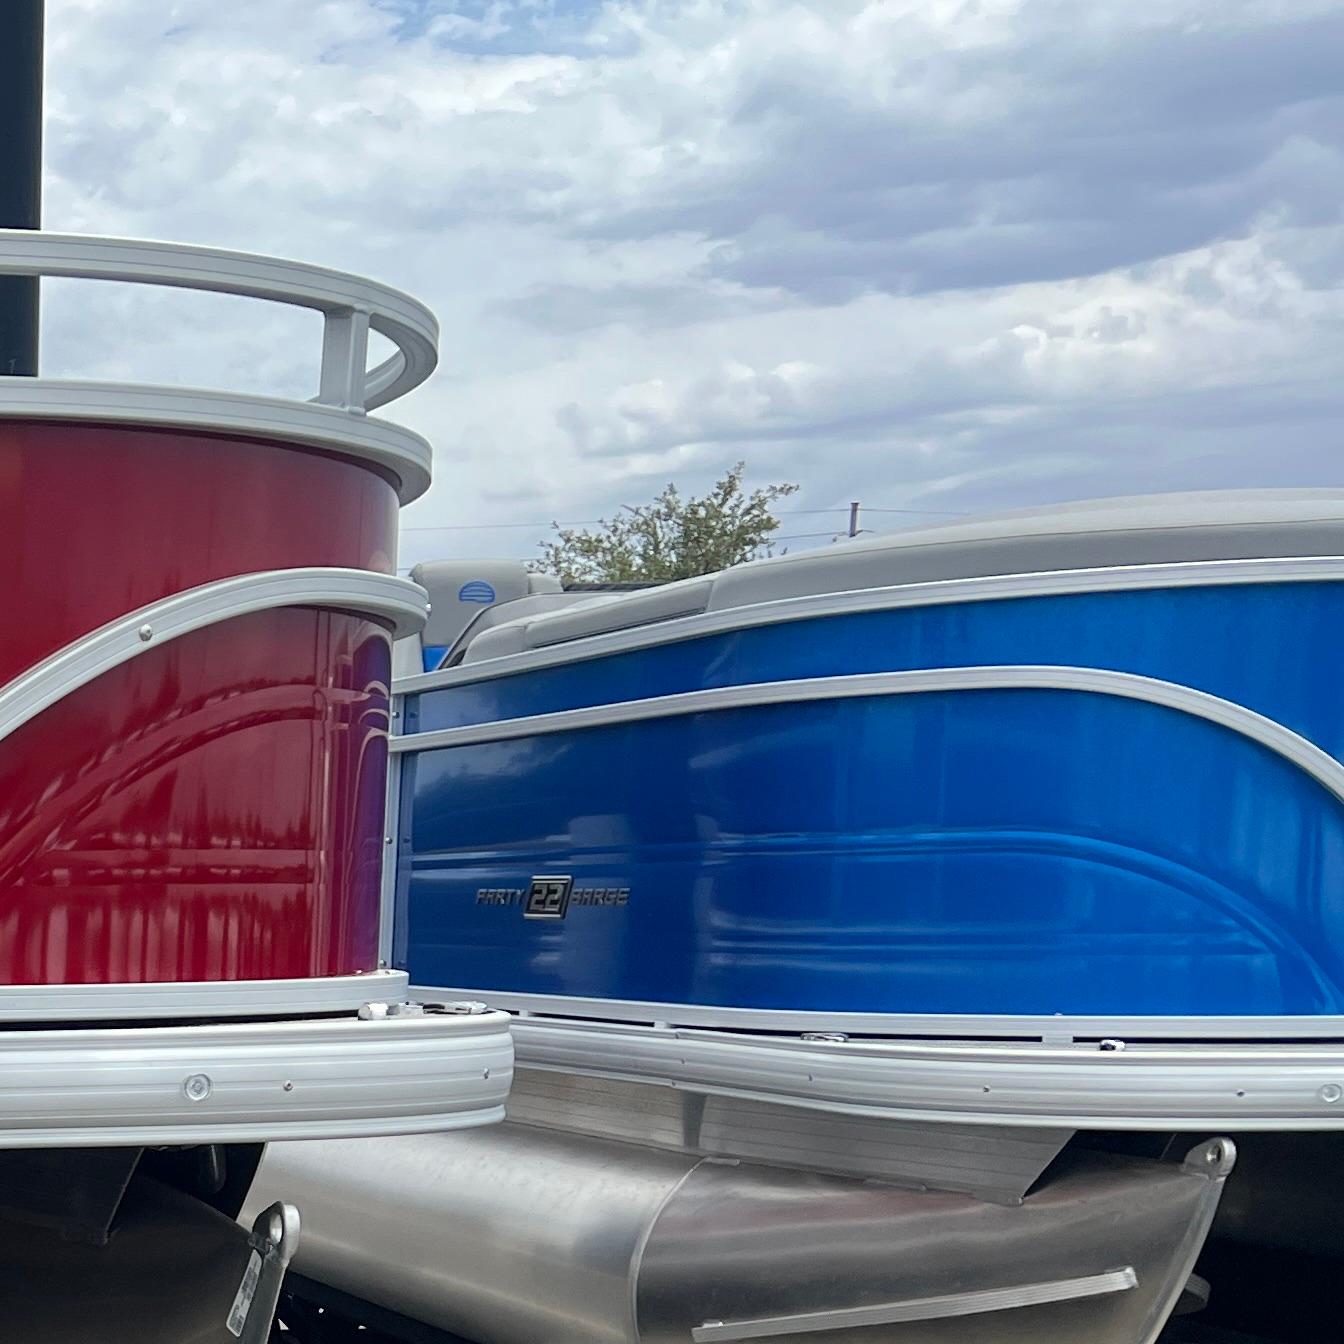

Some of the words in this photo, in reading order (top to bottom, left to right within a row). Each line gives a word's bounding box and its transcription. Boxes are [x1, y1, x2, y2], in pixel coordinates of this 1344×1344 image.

[476, 888, 525, 905] PARTY
[529, 883, 563, 912] 22
[571, 888, 631, 905] BARGE
